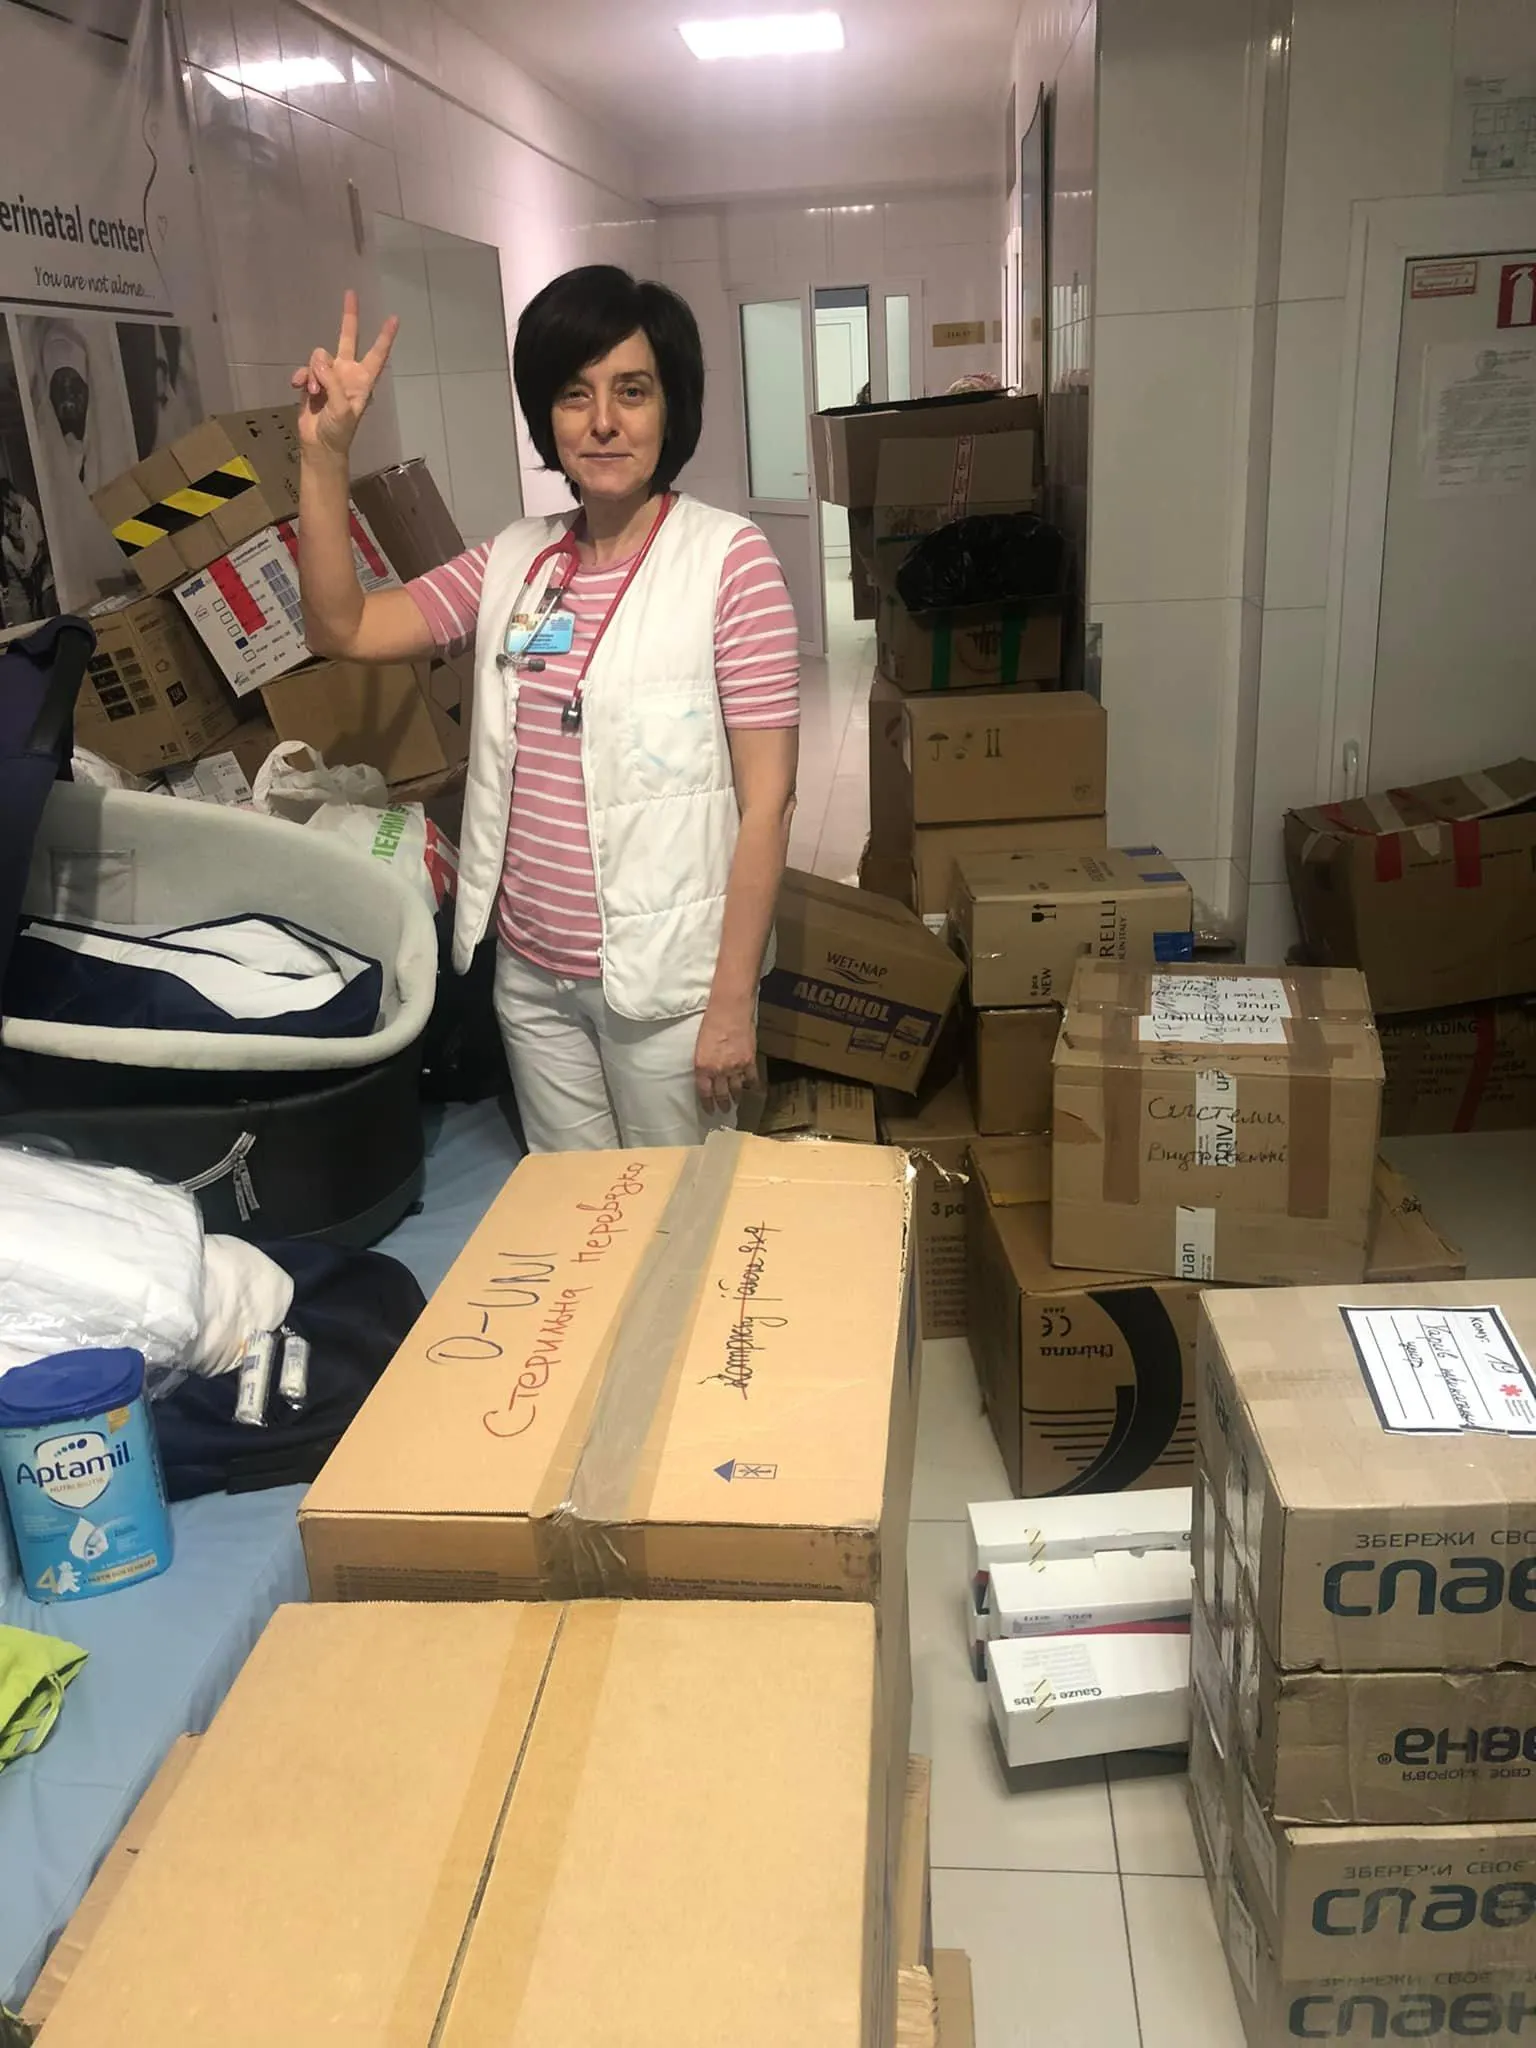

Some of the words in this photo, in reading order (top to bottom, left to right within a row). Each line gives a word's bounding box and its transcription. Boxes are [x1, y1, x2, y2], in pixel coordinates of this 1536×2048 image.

[88, 217, 145, 254] center
[34, 265, 62, 288] You
[62, 274, 87, 291] are
[88, 273, 110, 294] not
[1040, 967, 1053, 997] NEW
[792, 980, 891, 1022] ALCOHOL
[1236, 1001, 1281, 1011] drug
[1469, 1316, 1490, 1343] Кому:
[1039, 1343, 1114, 1359] Chirana
[16, 1440, 131, 1489] Aptamil
[1356, 1530, 1475, 1550] ЗБЕРЕЖИ
[35, 1566, 58, 1590] 4
[1013, 1693, 1057, 1707] sabs
[1060, 1686, 1103, 1700] Gauze
[1343, 1864, 1453, 1880] ЗБЕРЕЖИ
